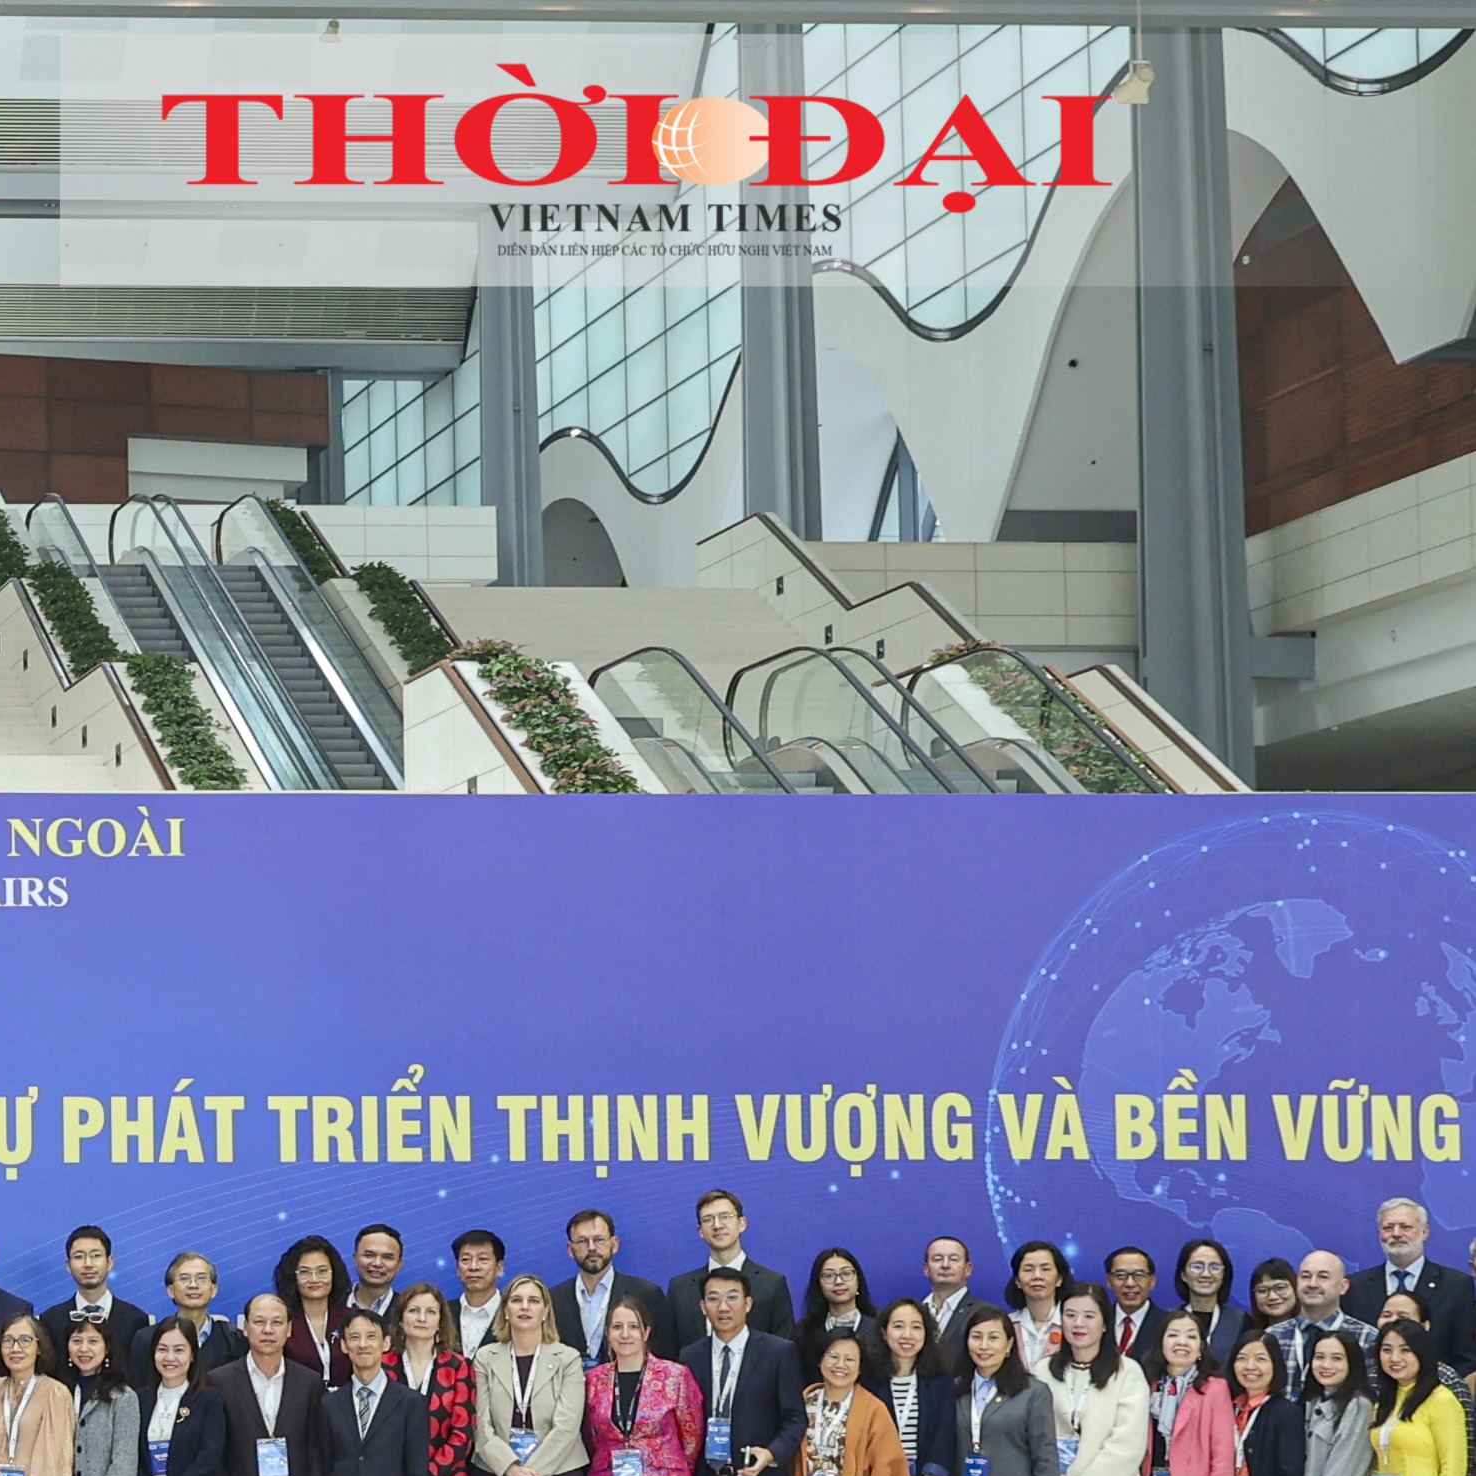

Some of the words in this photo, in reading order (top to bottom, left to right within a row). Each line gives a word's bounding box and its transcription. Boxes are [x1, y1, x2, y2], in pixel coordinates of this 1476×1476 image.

[8, 806, 183, 857] NGOÀI
[64, 1079, 244, 1162] PHÁT
[269, 1065, 471, 1161] TRIỂN
[498, 1095, 709, 1177] THỊNH
[737, 1085, 973, 1176] VƯỢNG
[999, 1077, 1089, 1159] VÀ
[1116, 1069, 1246, 1160] BỀN
[1274, 1080, 1460, 1161] VỮNG
